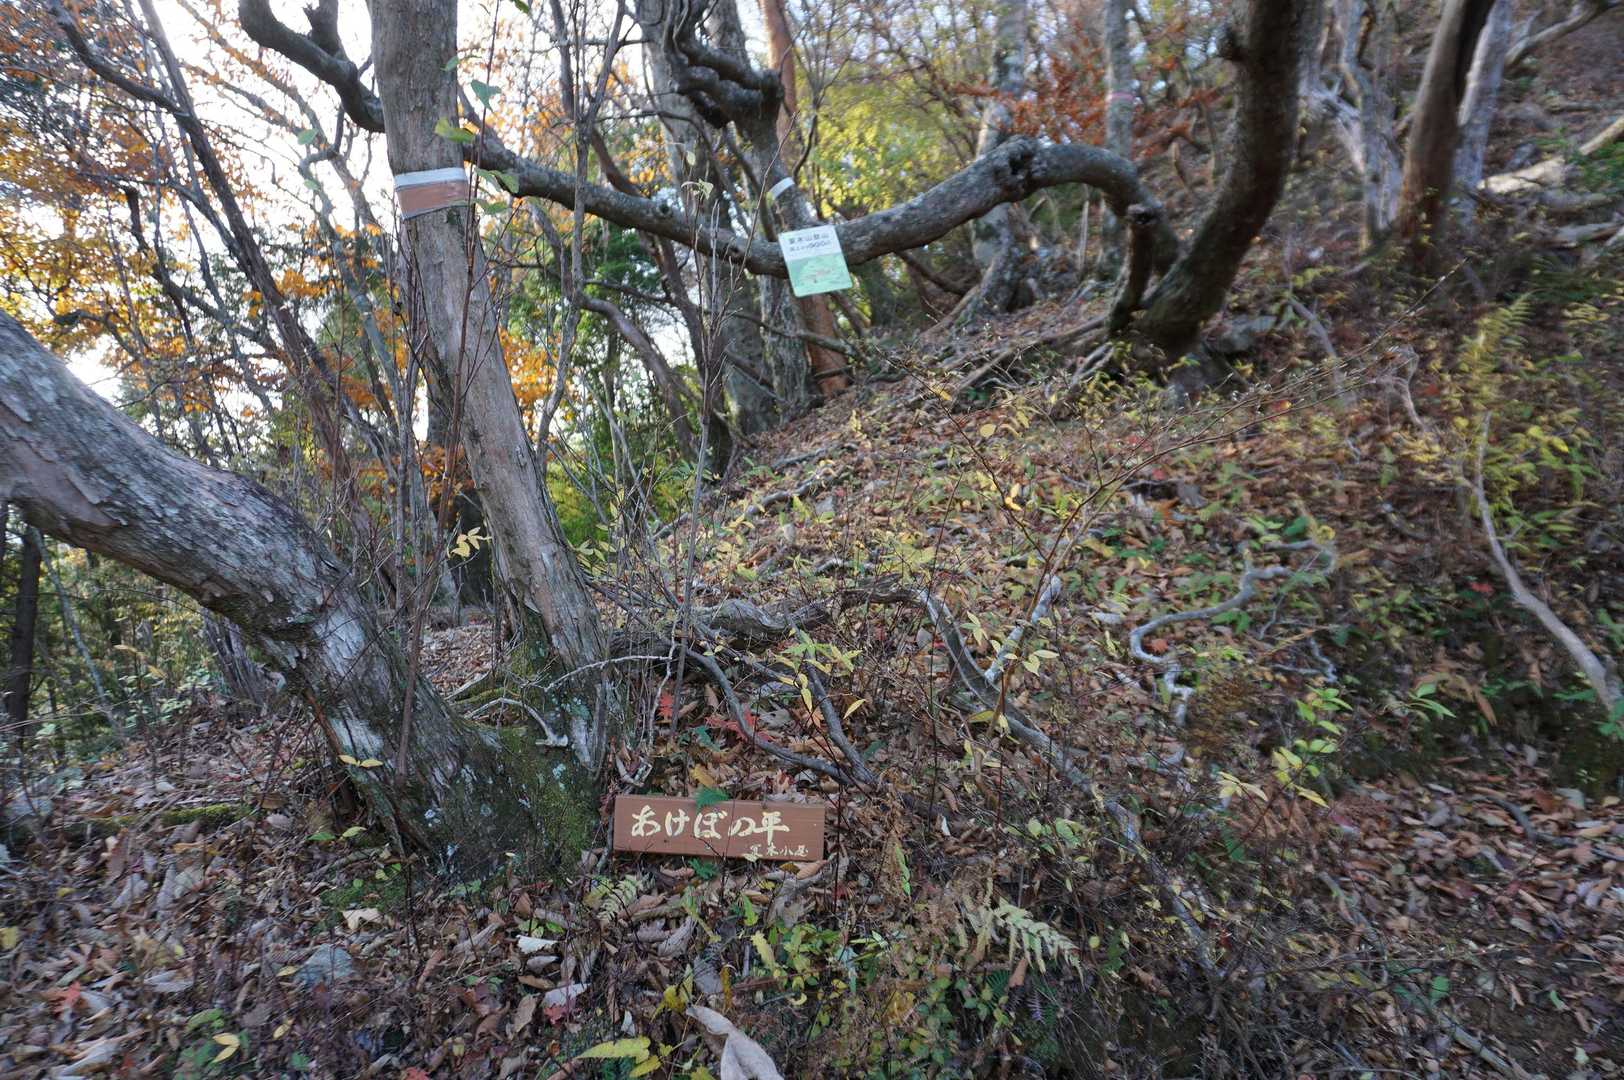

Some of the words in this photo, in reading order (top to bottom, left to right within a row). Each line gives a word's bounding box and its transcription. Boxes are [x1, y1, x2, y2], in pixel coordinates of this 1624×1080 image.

[631, 804, 790, 845] あけぼの平
